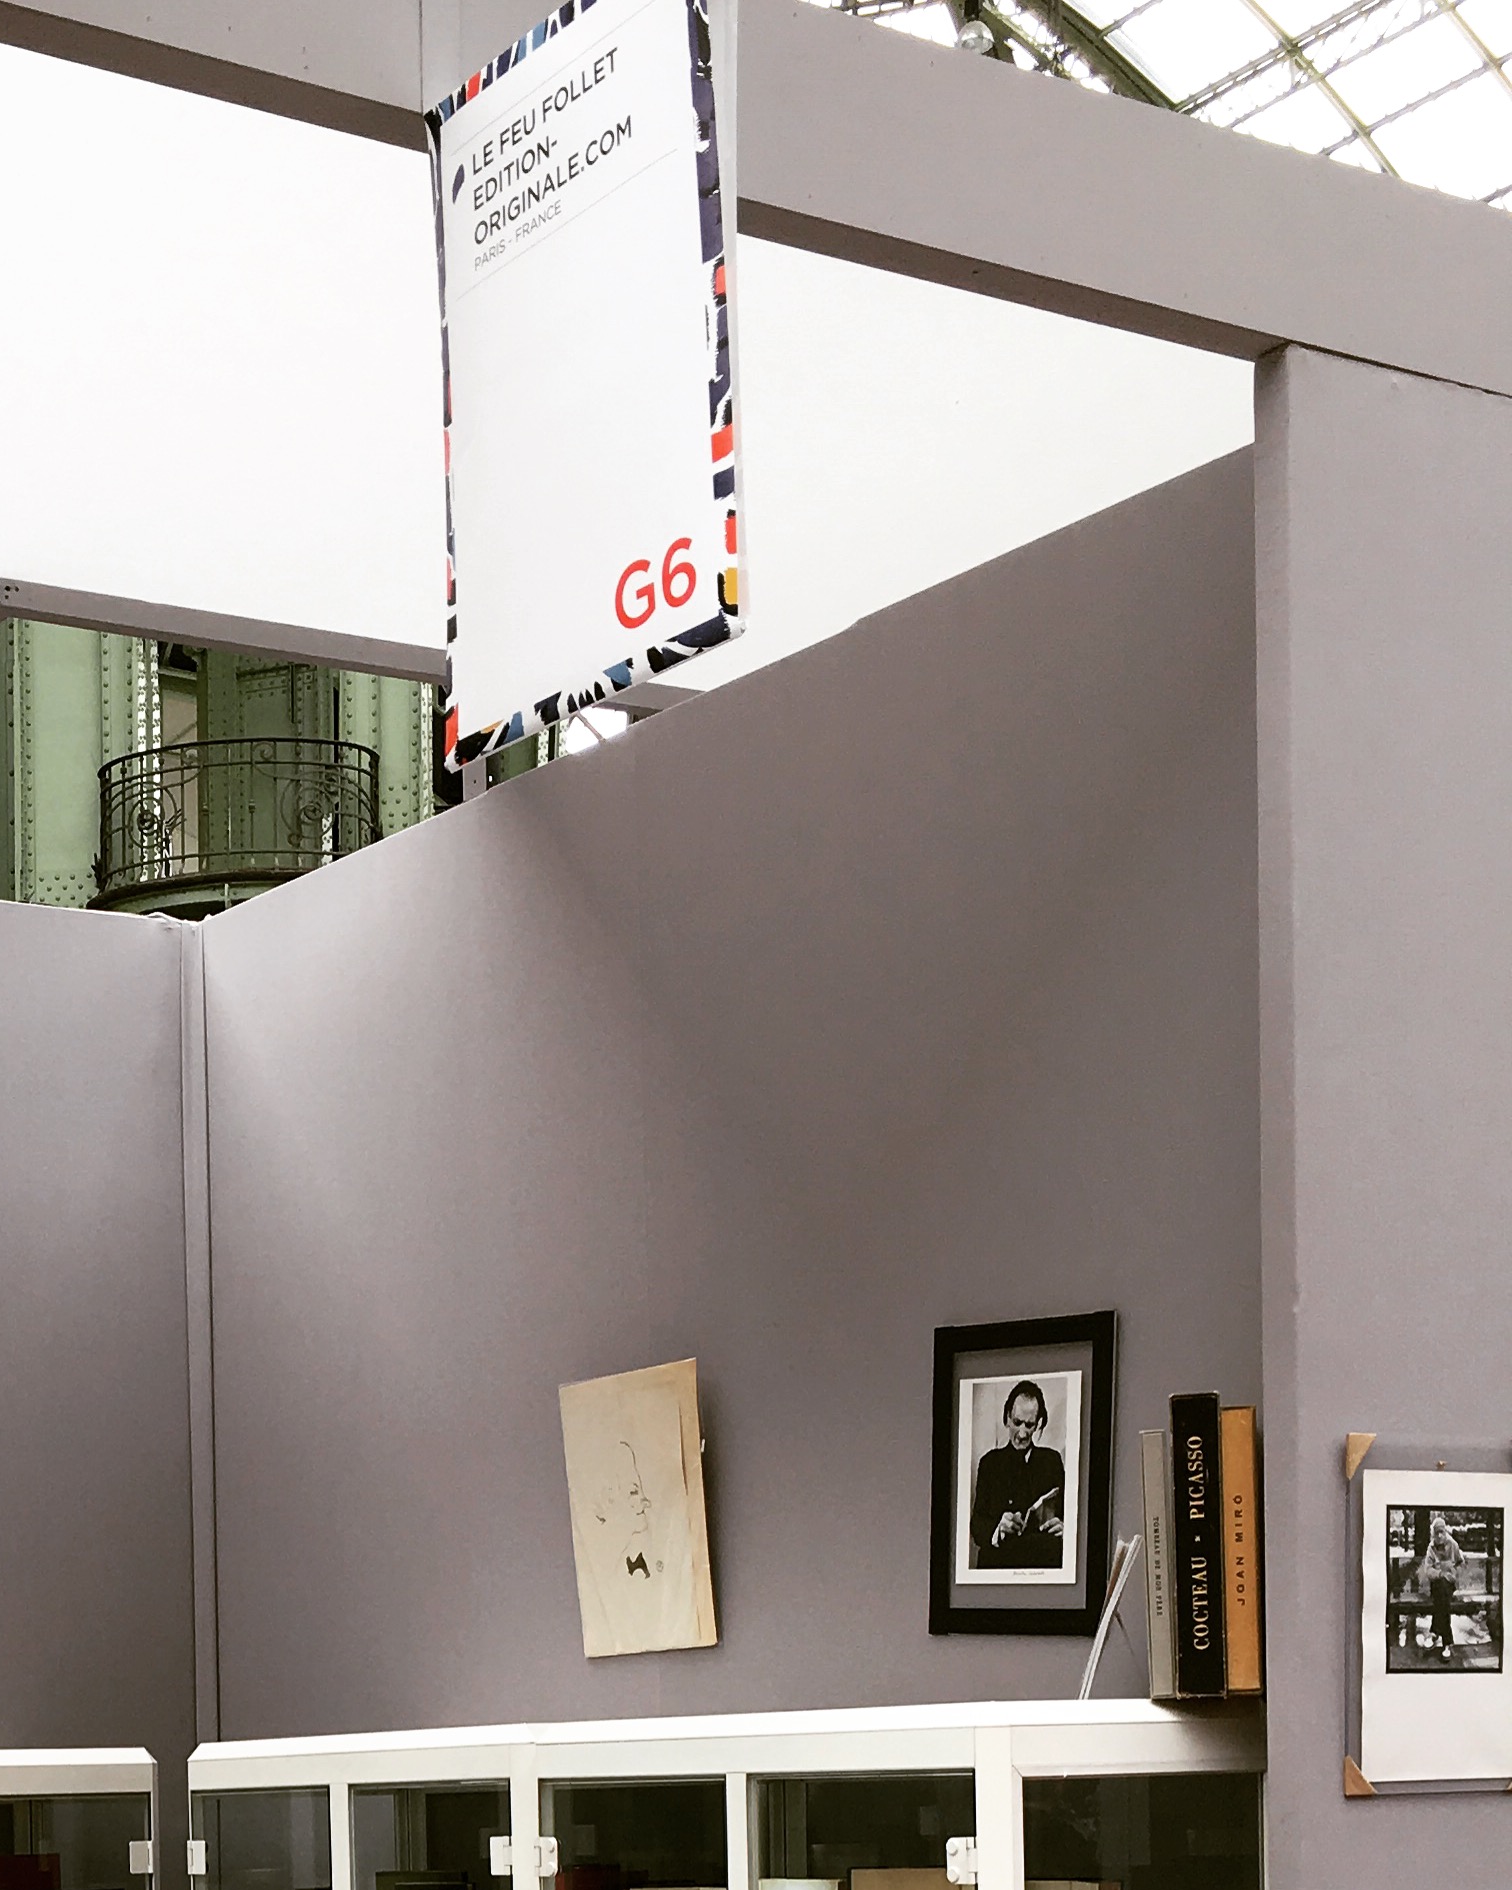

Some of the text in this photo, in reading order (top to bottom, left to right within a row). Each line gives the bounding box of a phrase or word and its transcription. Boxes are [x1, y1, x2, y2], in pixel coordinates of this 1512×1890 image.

[472, 47, 619, 176] LE FEU FOLLET
[473, 136, 558, 211] EDITION-
[474, 115, 632, 246] ORIGINALE.COM
[474, 239, 506, 272] PARIS
[515, 199, 563, 243] FRANCE
[615, 536, 697, 630] G6
[1187, 1435, 1209, 1650] COCTEAU PICASSO
[1235, 1555, 1246, 1606] JOAN
